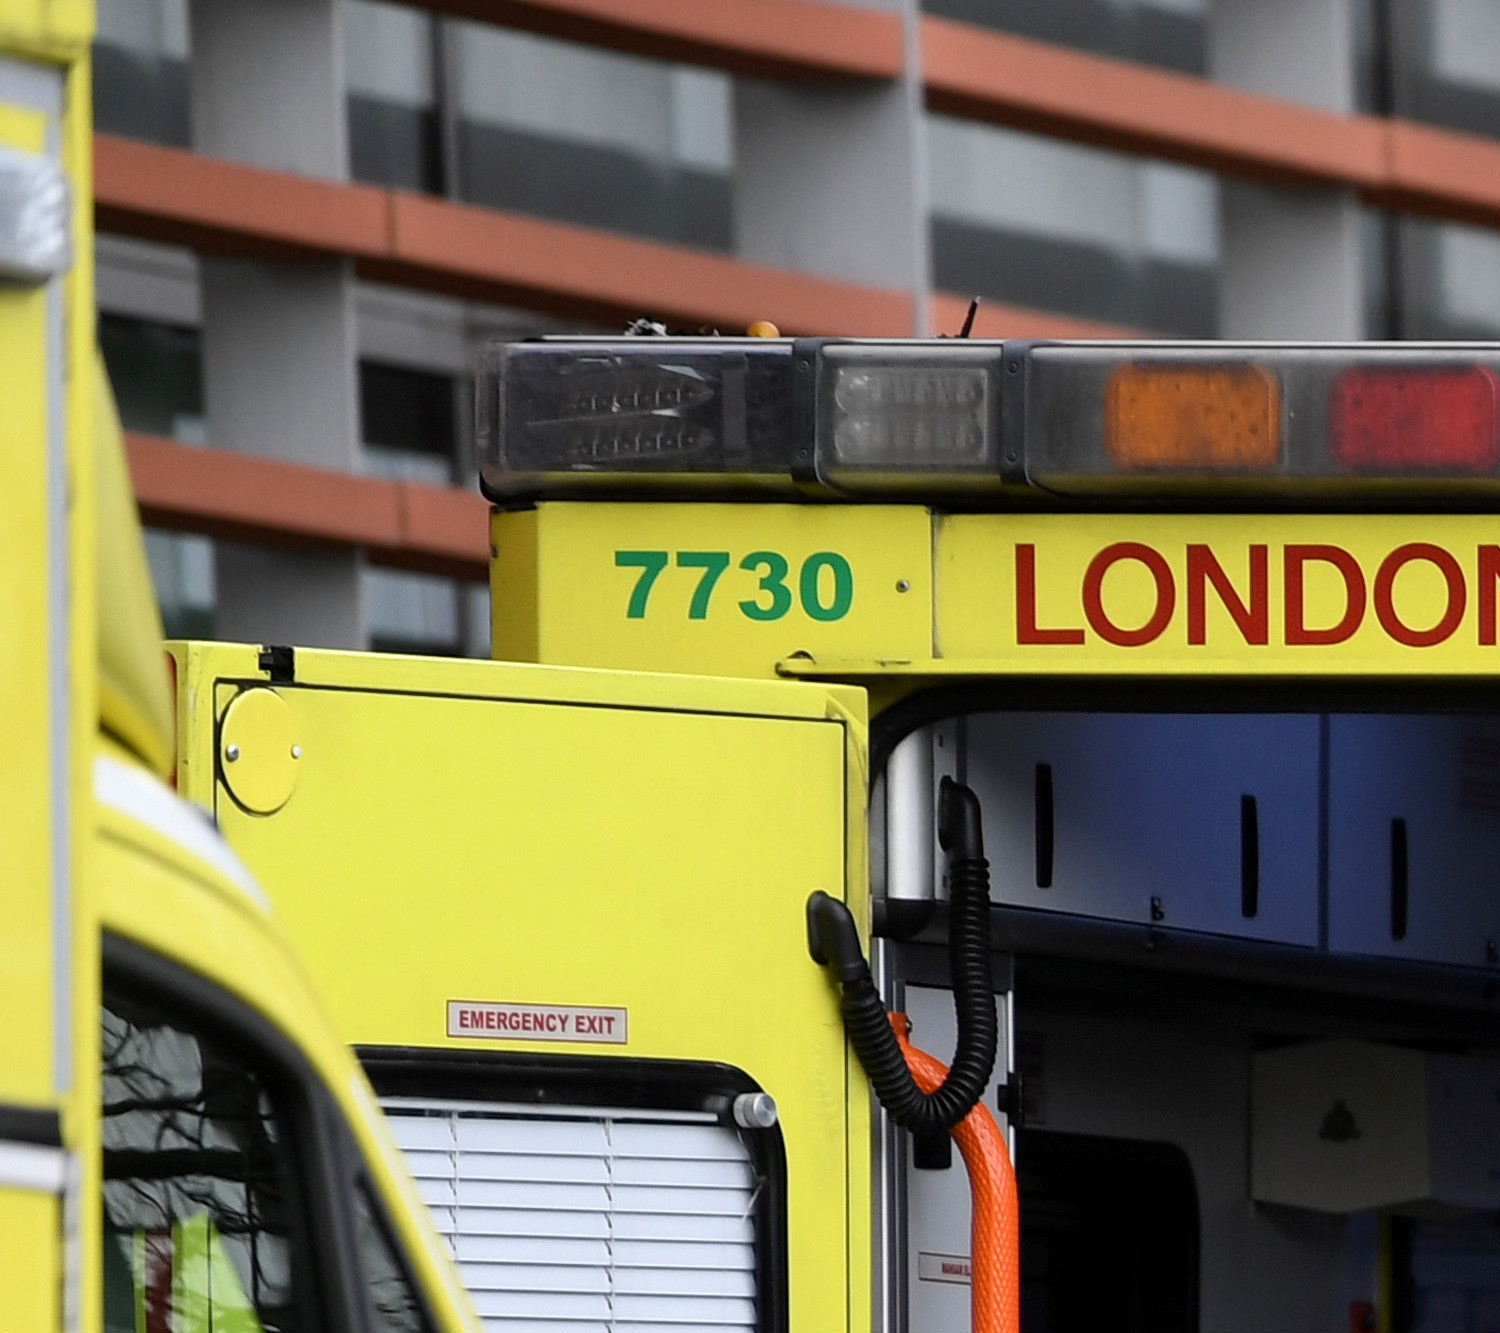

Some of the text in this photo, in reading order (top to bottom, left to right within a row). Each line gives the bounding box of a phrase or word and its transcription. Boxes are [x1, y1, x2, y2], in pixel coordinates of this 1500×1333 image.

[613, 549, 854, 622] 7730
[459, 1009, 616, 1035] EMERGENCY EXIT
